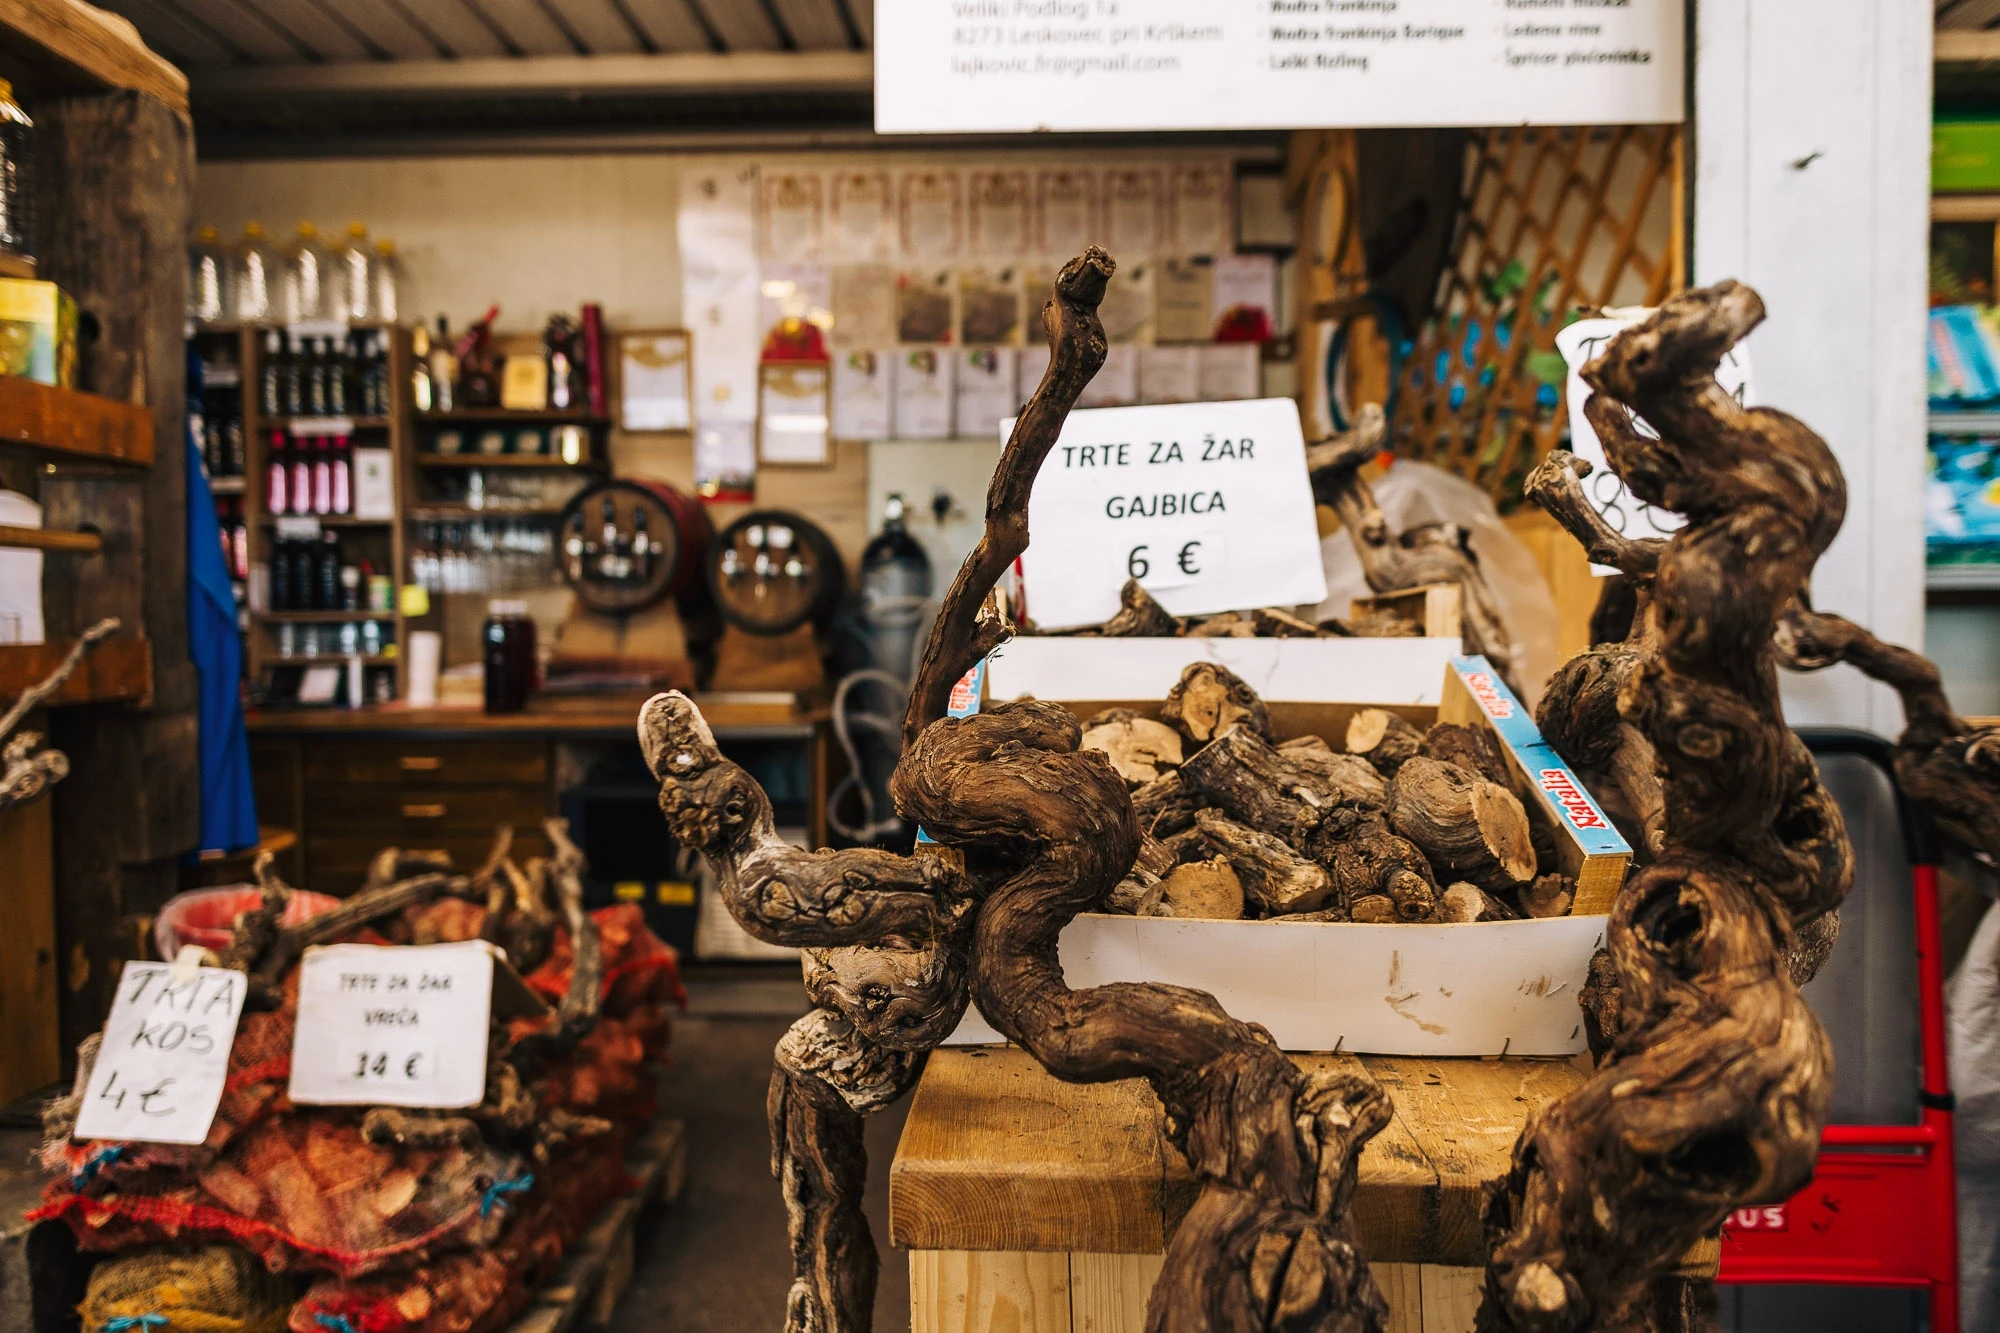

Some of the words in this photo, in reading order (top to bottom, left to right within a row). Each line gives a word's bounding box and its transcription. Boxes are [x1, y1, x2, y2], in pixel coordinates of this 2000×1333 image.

[1062, 443, 1132, 468] TRTE
[1149, 441, 1183, 464] ZA
[1201, 433, 1255, 461] ŽAR
[1106, 491, 1226, 519] GAJBICA
[1127, 545, 1150, 579] 6
[1177, 540, 1202, 575] €
[1541, 769, 1608, 830] Natalia
[131, 1018, 214, 1055] KOS
[354, 1051, 388, 1080] 14
[404, 1051, 423, 1080] €
